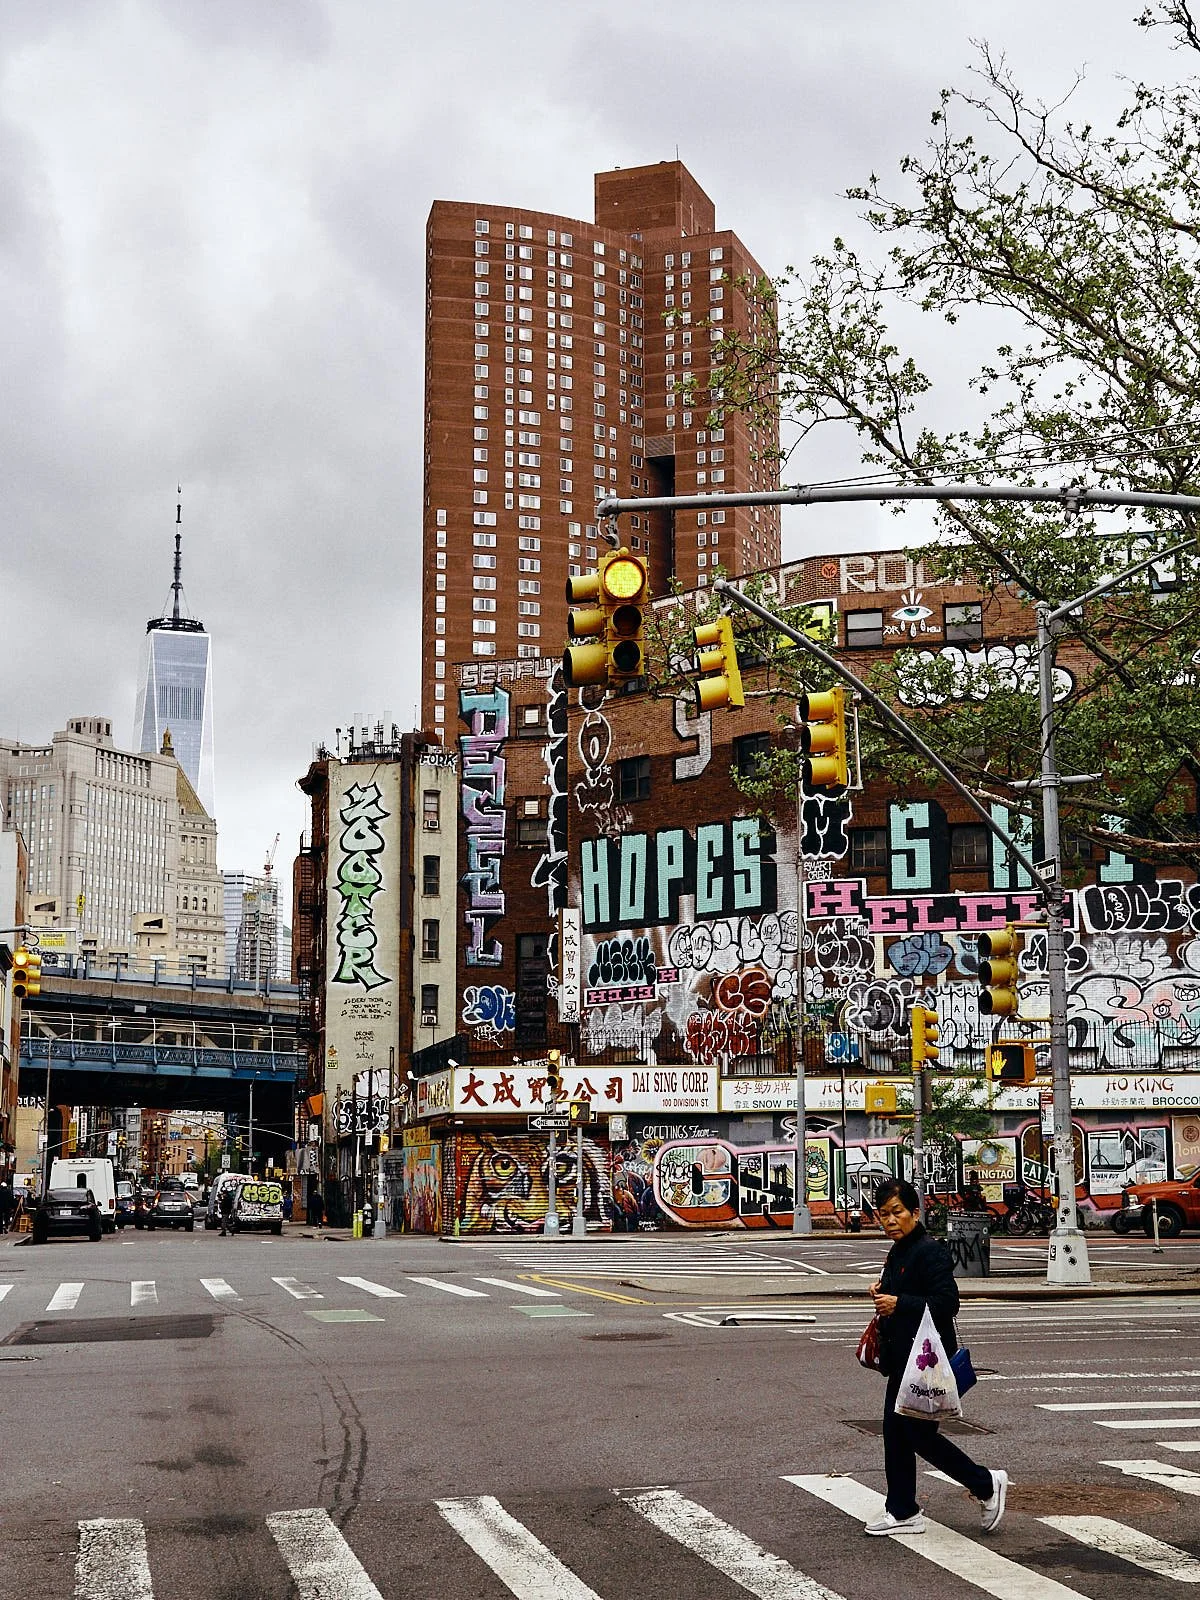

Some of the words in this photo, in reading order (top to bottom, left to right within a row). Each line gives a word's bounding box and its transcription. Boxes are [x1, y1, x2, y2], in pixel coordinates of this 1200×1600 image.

[420, 752, 457, 768] FORK
[581, 819, 762, 925] HOPES
[804, 861, 836, 872] SMART
[332, 782, 392, 992] ZOOTER
[564, 918, 578, 1014] 大成貿易公司
[632, 1072, 650, 1093] DAI
[654, 1072, 677, 1093] SING
[682, 1072, 709, 1093] CORP.
[1105, 1077, 1128, 1093] HO
[1134, 1077, 1174, 1093] KING
[662, 1098, 672, 1107] 100
[674, 1098, 699, 1106] DIVISION
[752, 1100, 782, 1109] SNOW
[787, 1100, 806, 1108] PE
[1153, 1097, 1200, 1106] BROCCO
[642, 1125, 689, 1140] GREETINGS
[966, 1169, 1014, 1179] TINGTAO
